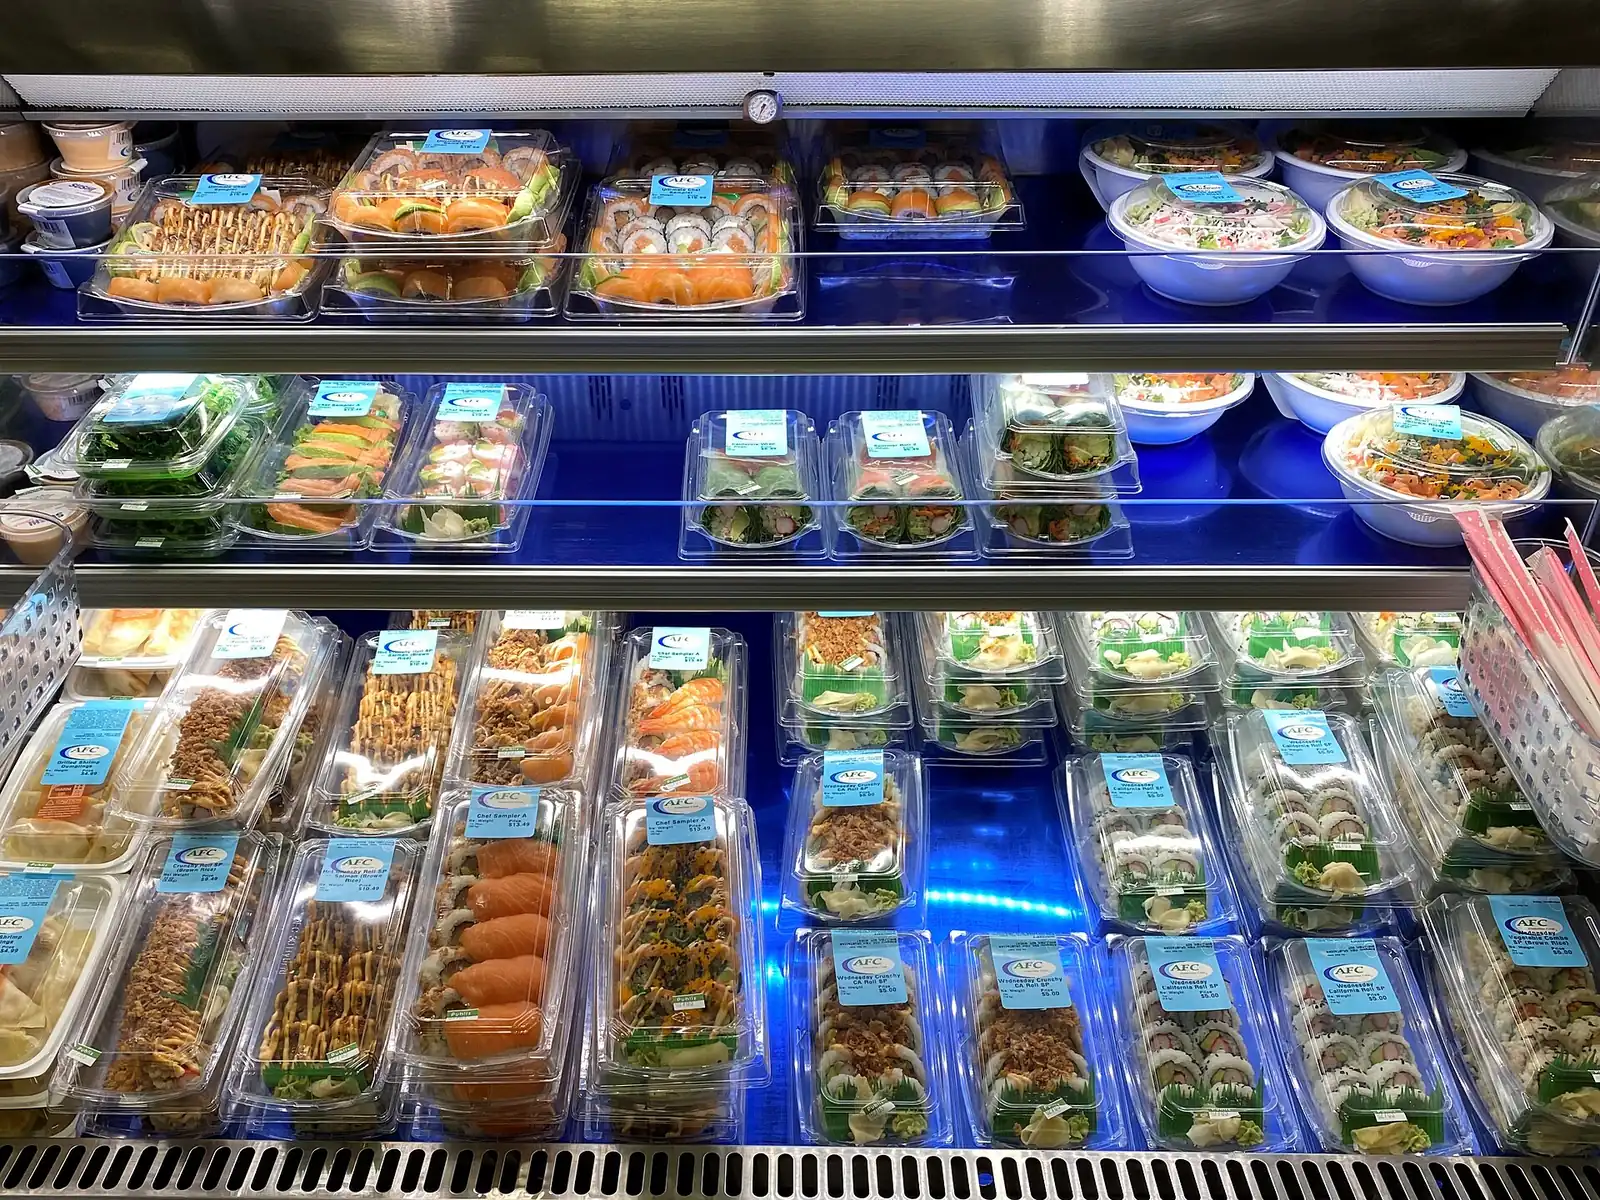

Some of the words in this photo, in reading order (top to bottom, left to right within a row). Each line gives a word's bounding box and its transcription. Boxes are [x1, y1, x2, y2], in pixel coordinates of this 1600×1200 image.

[490, 792, 520, 800] AFC
[664, 798, 694, 806] AFC
[187, 849, 217, 857] AFC
[1516, 919, 1548, 927] AFC
[853, 958, 882, 966] AFC
[1013, 962, 1043, 970] AFC
[1335, 966, 1364, 975] AFC
